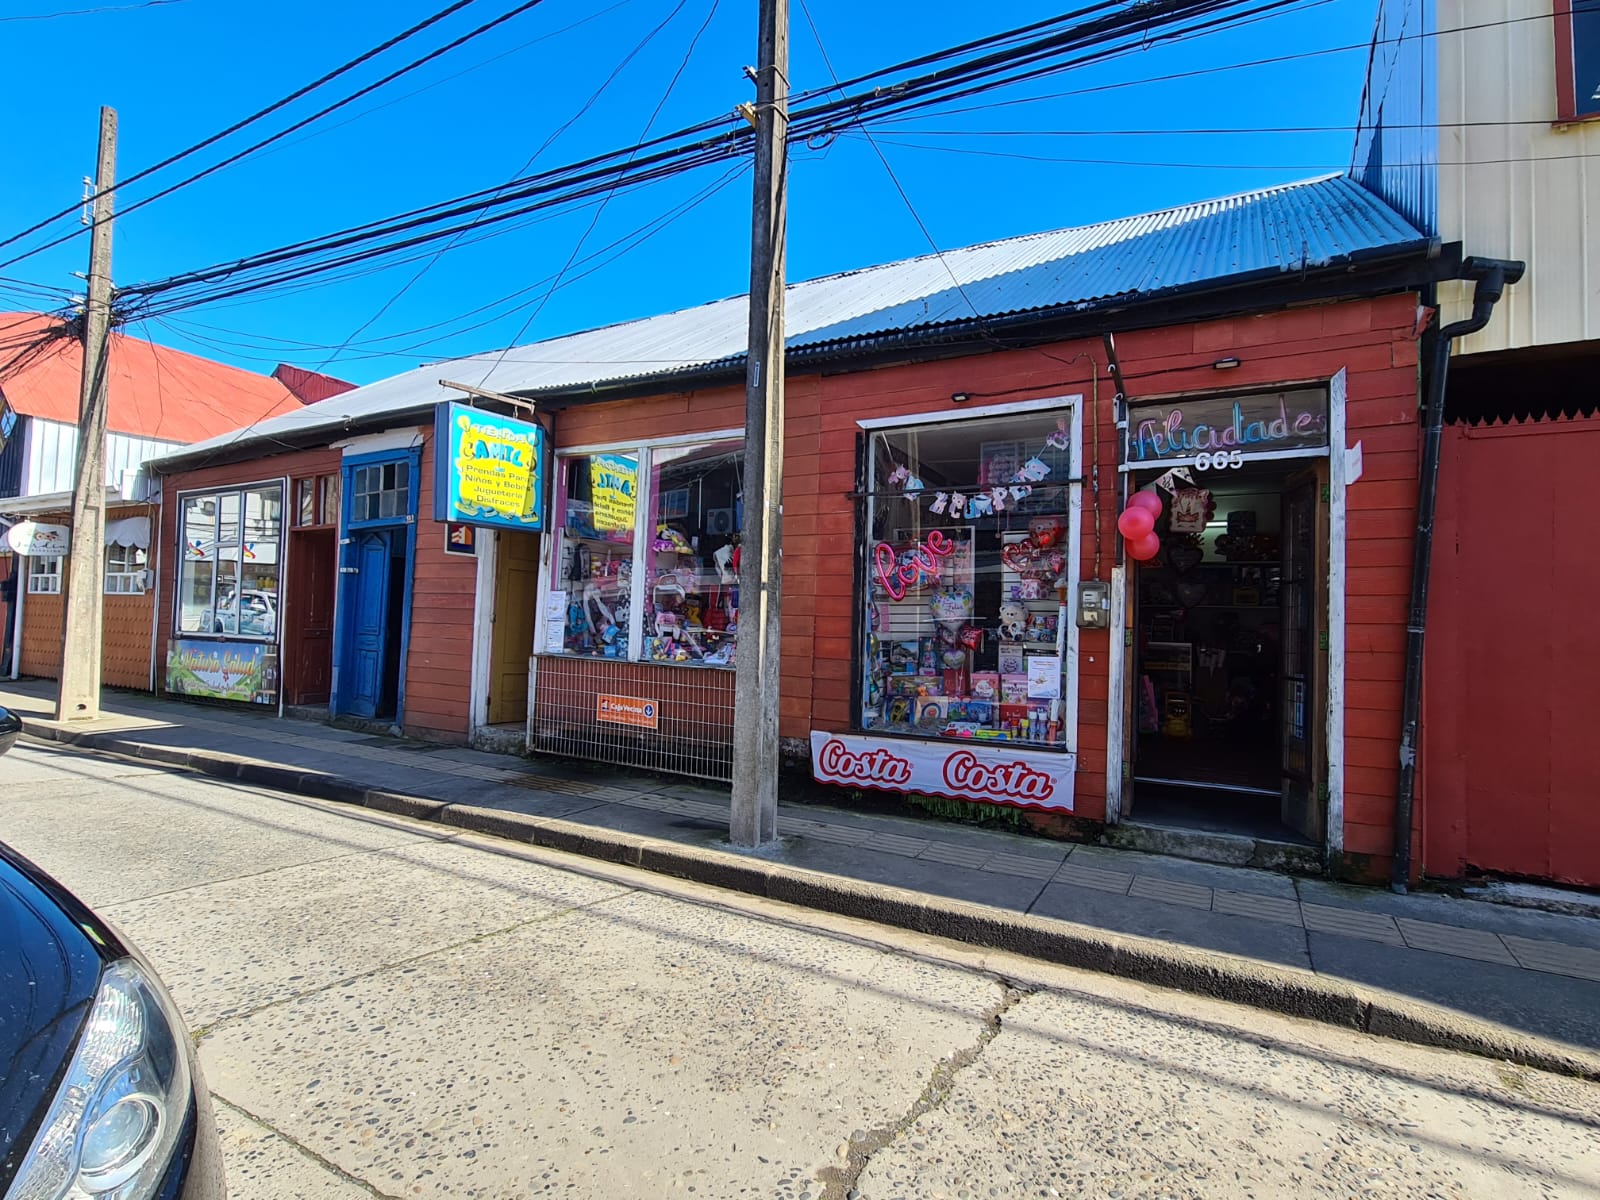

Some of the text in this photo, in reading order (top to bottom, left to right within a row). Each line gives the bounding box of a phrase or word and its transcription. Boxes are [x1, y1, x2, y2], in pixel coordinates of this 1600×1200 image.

[1195, 450, 1243, 471] 665
[466, 464, 506, 478] Prendas
[465, 474, 493, 485] Niños
[476, 494, 521, 507] Disfraces
[819, 739, 1054, 801] Costa Costa
